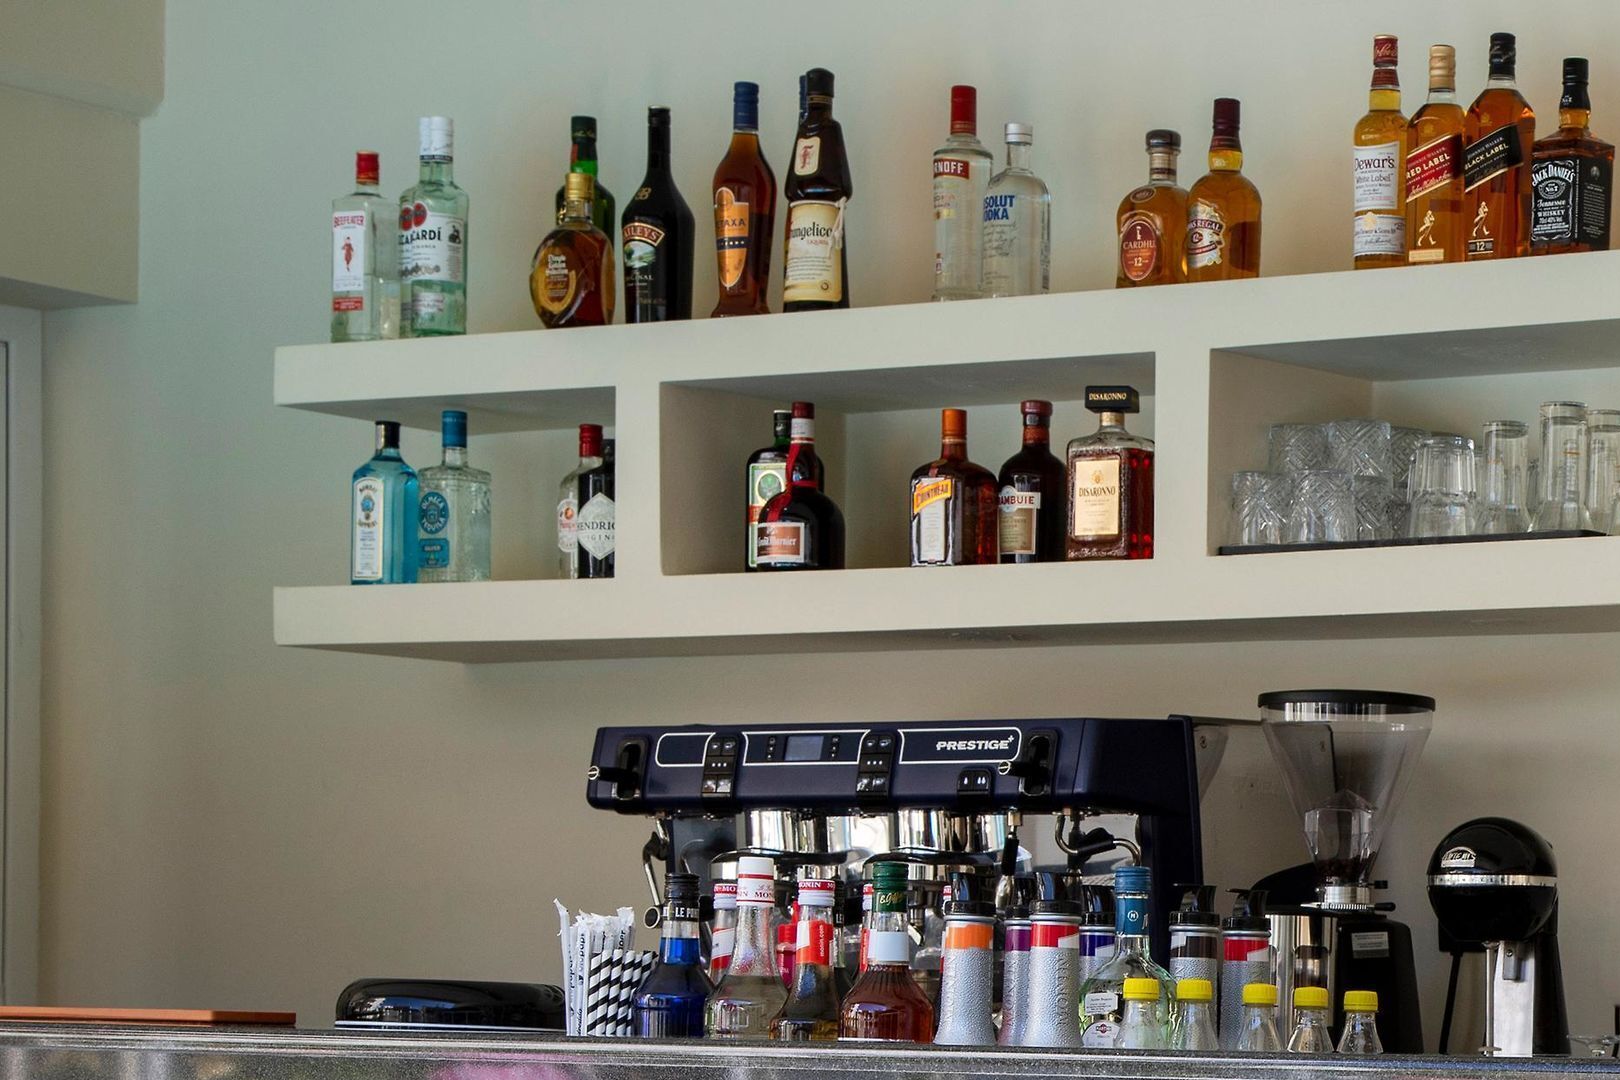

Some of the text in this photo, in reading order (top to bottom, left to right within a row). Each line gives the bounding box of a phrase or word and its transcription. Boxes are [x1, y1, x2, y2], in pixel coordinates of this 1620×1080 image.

[1486, 143, 1509, 158] LABEL
[1423, 153, 1451, 170] LABEL
[1532, 168, 1549, 187] JACK
[623, 225, 658, 241] AILEYS
[1475, 241, 1486, 252] 12
[1088, 391, 1127, 401] DISARONNO
[1078, 485, 1117, 498] DISARONNO
